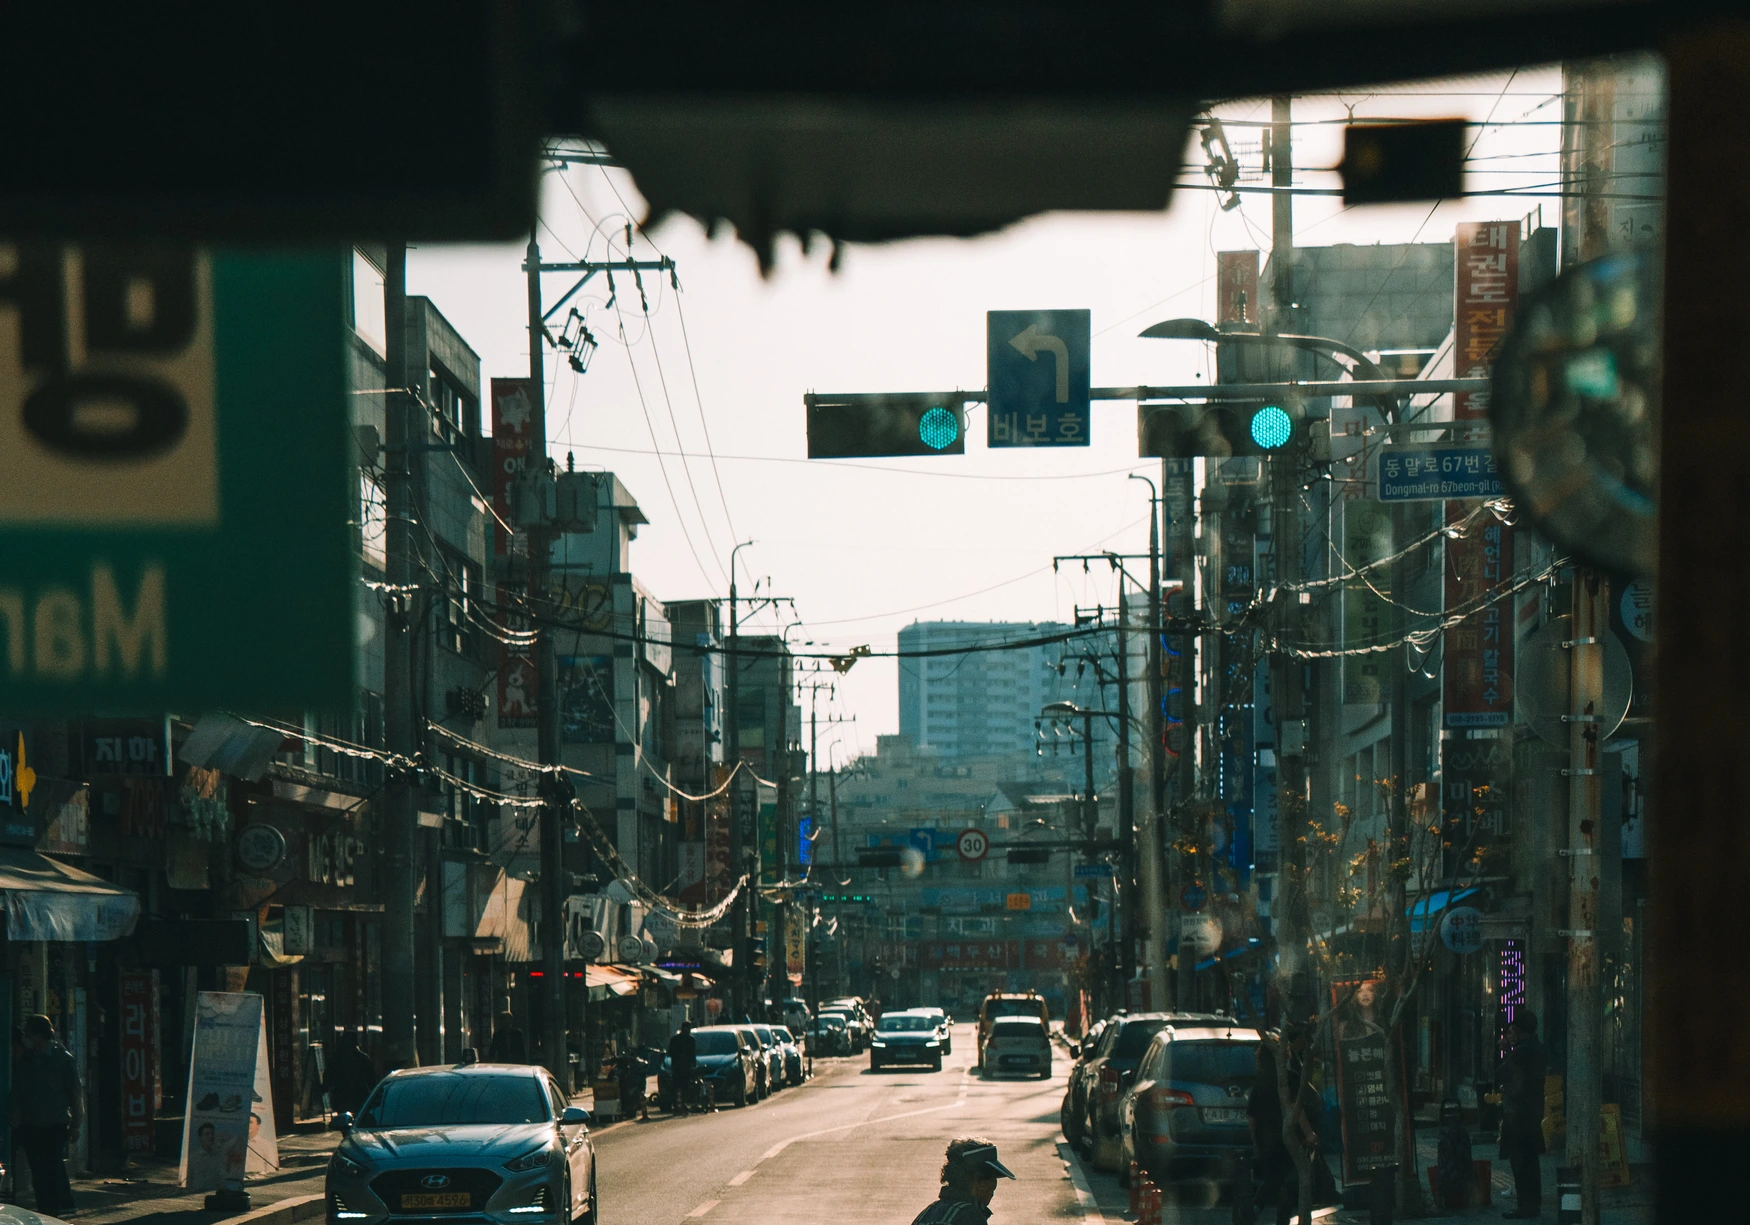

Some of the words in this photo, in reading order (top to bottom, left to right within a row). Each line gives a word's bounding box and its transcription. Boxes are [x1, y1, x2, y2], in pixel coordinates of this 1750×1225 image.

[1465, 225, 1509, 303] 태권도
[993, 411, 1084, 445] 비보호
[1385, 482, 1439, 497] Dongmal-ro
[1441, 479, 1490, 495] 67beon-gil
[1482, 648, 1500, 705] 칼국수
[1450, 779, 1504, 805] 미소
[1450, 809, 1504, 837] 카페
[964, 838, 982, 852] 30
[124, 1003, 149, 1128] 라이브
[1347, 1047, 1384, 1063] 늘본헤
[436, 1193, 466, 1206] 4596
